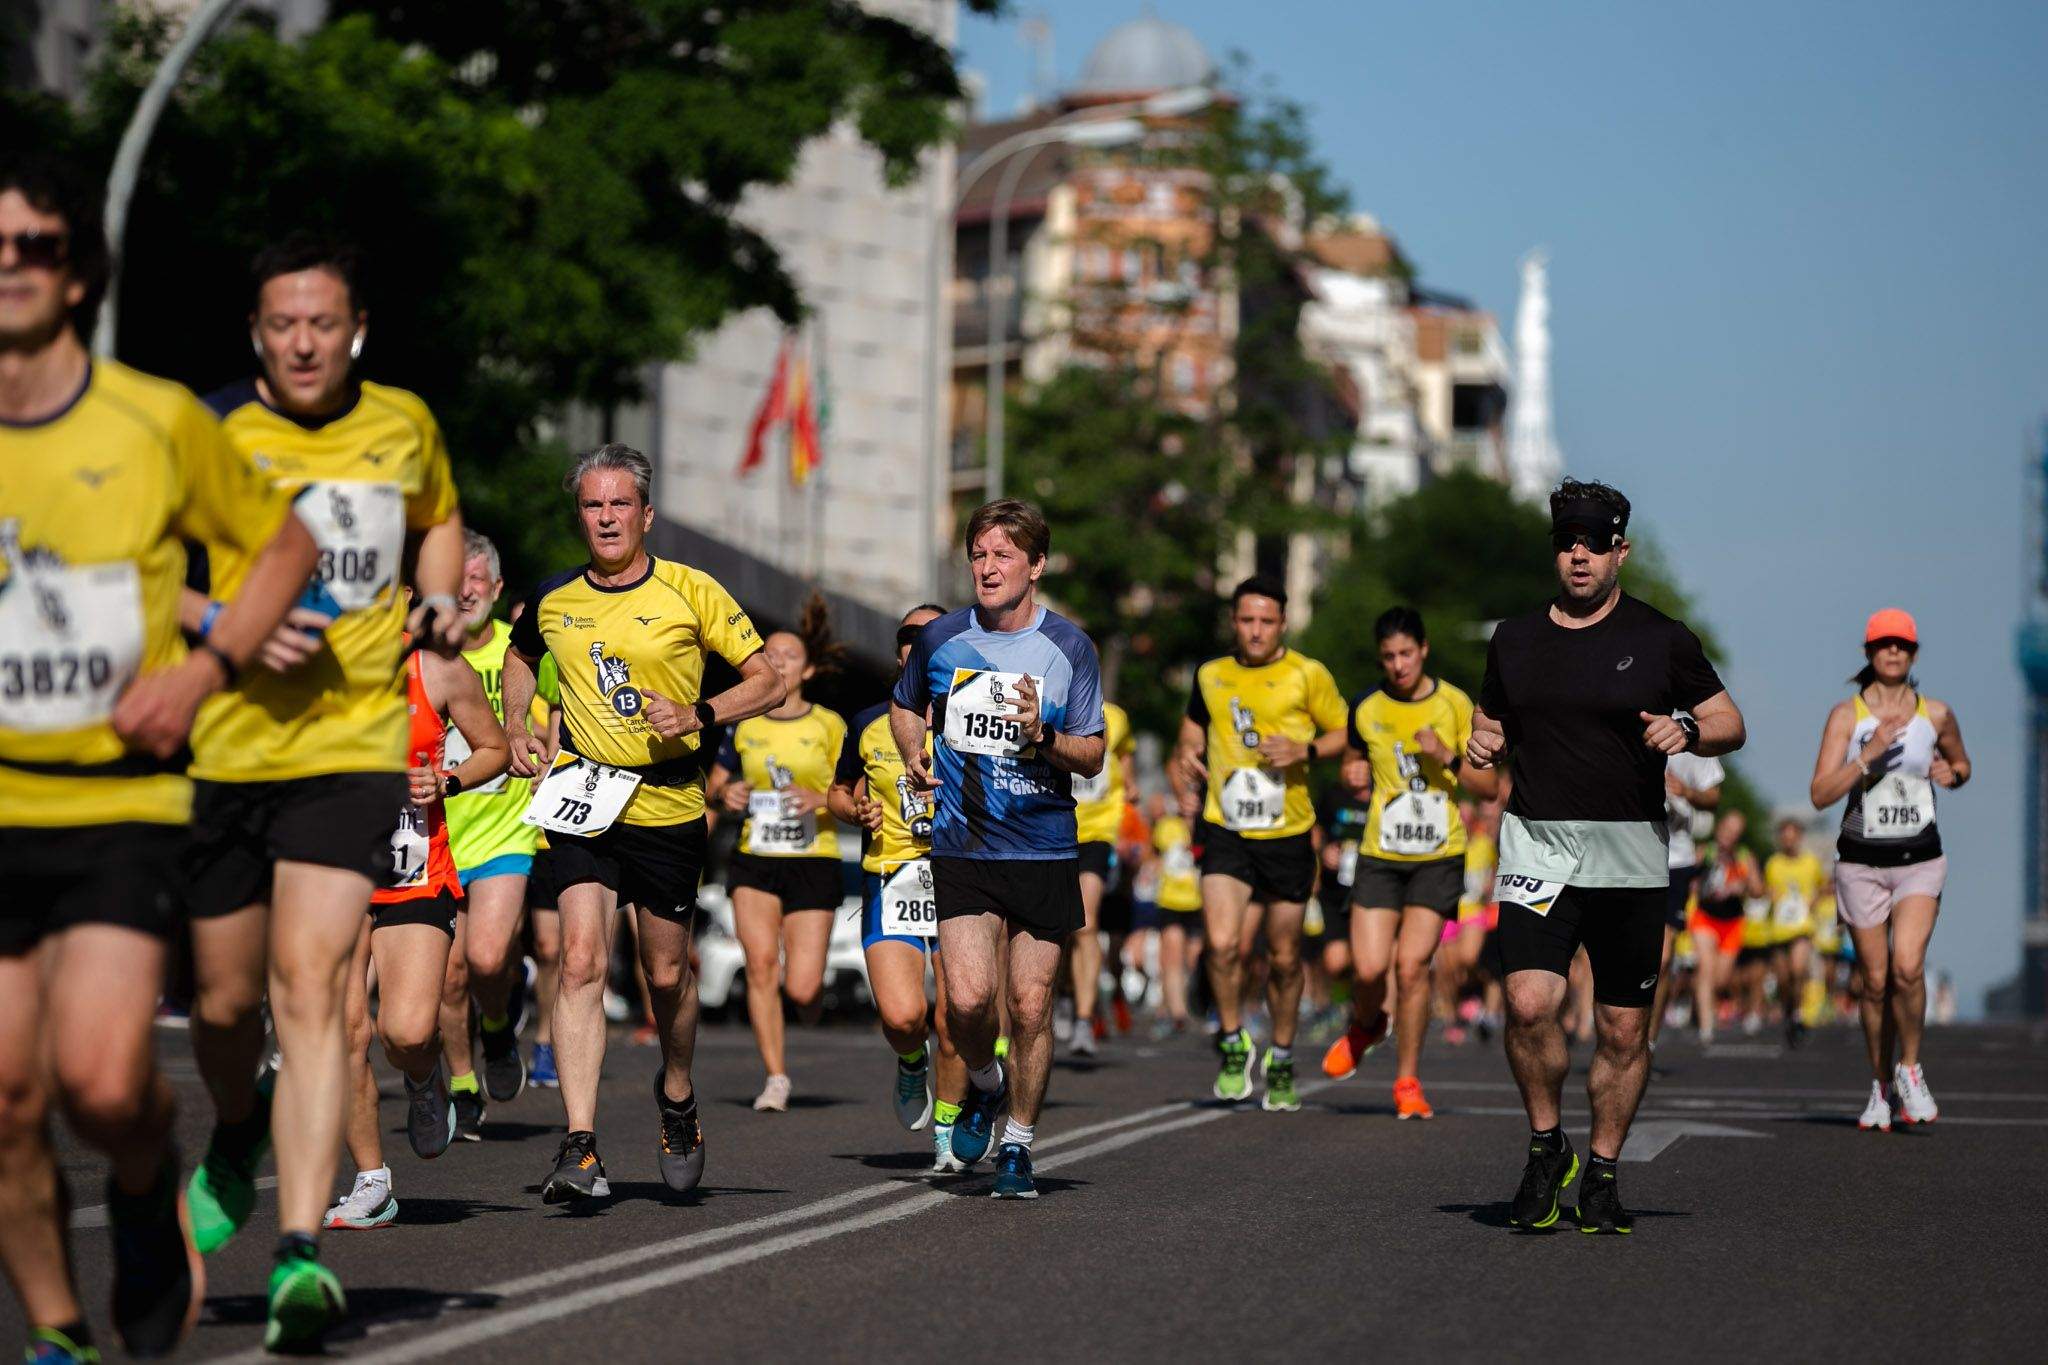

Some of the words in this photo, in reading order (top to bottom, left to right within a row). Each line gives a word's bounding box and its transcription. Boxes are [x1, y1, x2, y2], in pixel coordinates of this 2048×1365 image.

[319, 548, 378, 582] 308
[617, 693, 637, 710] 13
[963, 713, 1019, 742] 1355
[993, 778, 1008, 790] EN
[553, 797, 592, 825] 773
[1237, 799, 1264, 818] 791
[1878, 805, 1920, 824] 3795
[1394, 823, 1436, 842] 1848
[895, 900, 936, 922] 286
